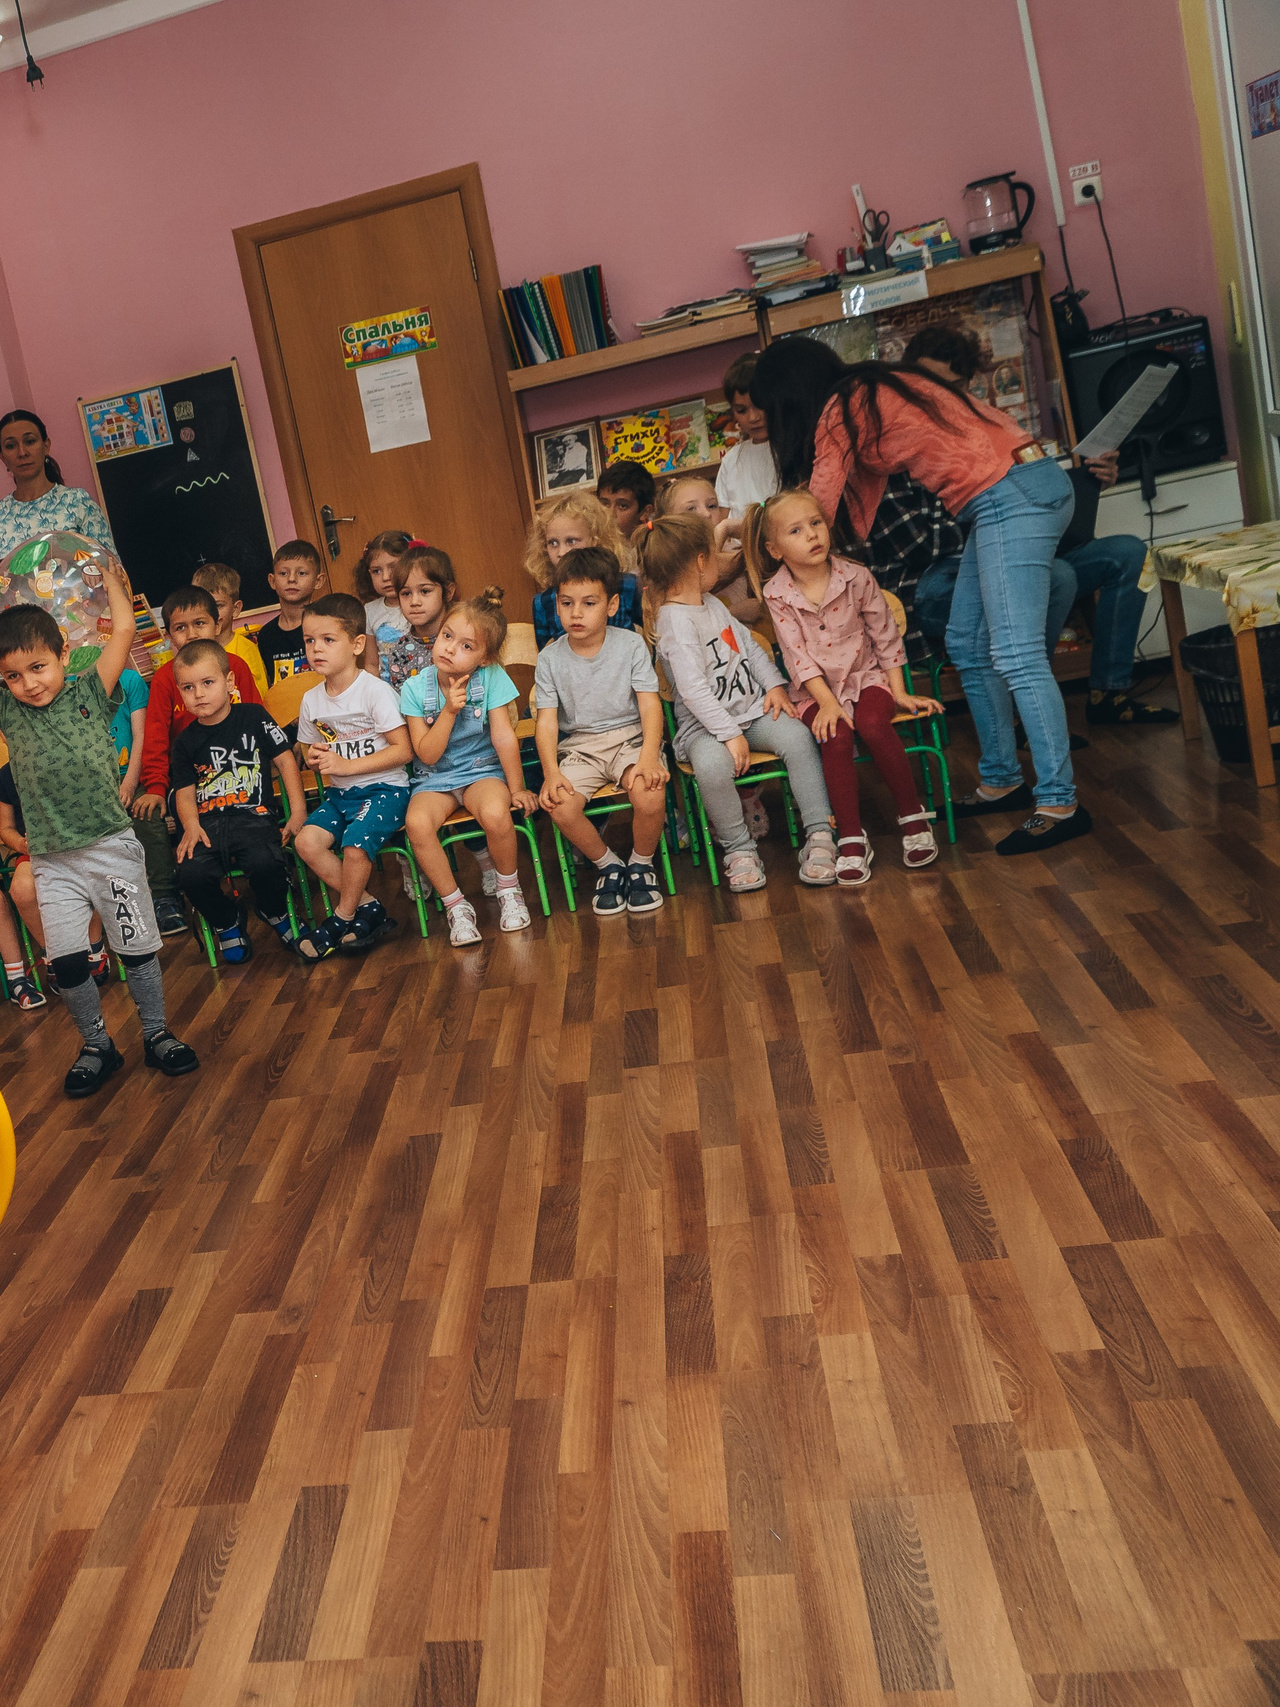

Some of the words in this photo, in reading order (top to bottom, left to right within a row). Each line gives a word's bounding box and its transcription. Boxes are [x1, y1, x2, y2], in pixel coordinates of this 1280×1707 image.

[1071, 166, 1088, 177] 220
[342, 312, 430, 345] Спальня
[614, 427, 660, 446] СТИХИ
[706, 637, 728, 670] I
